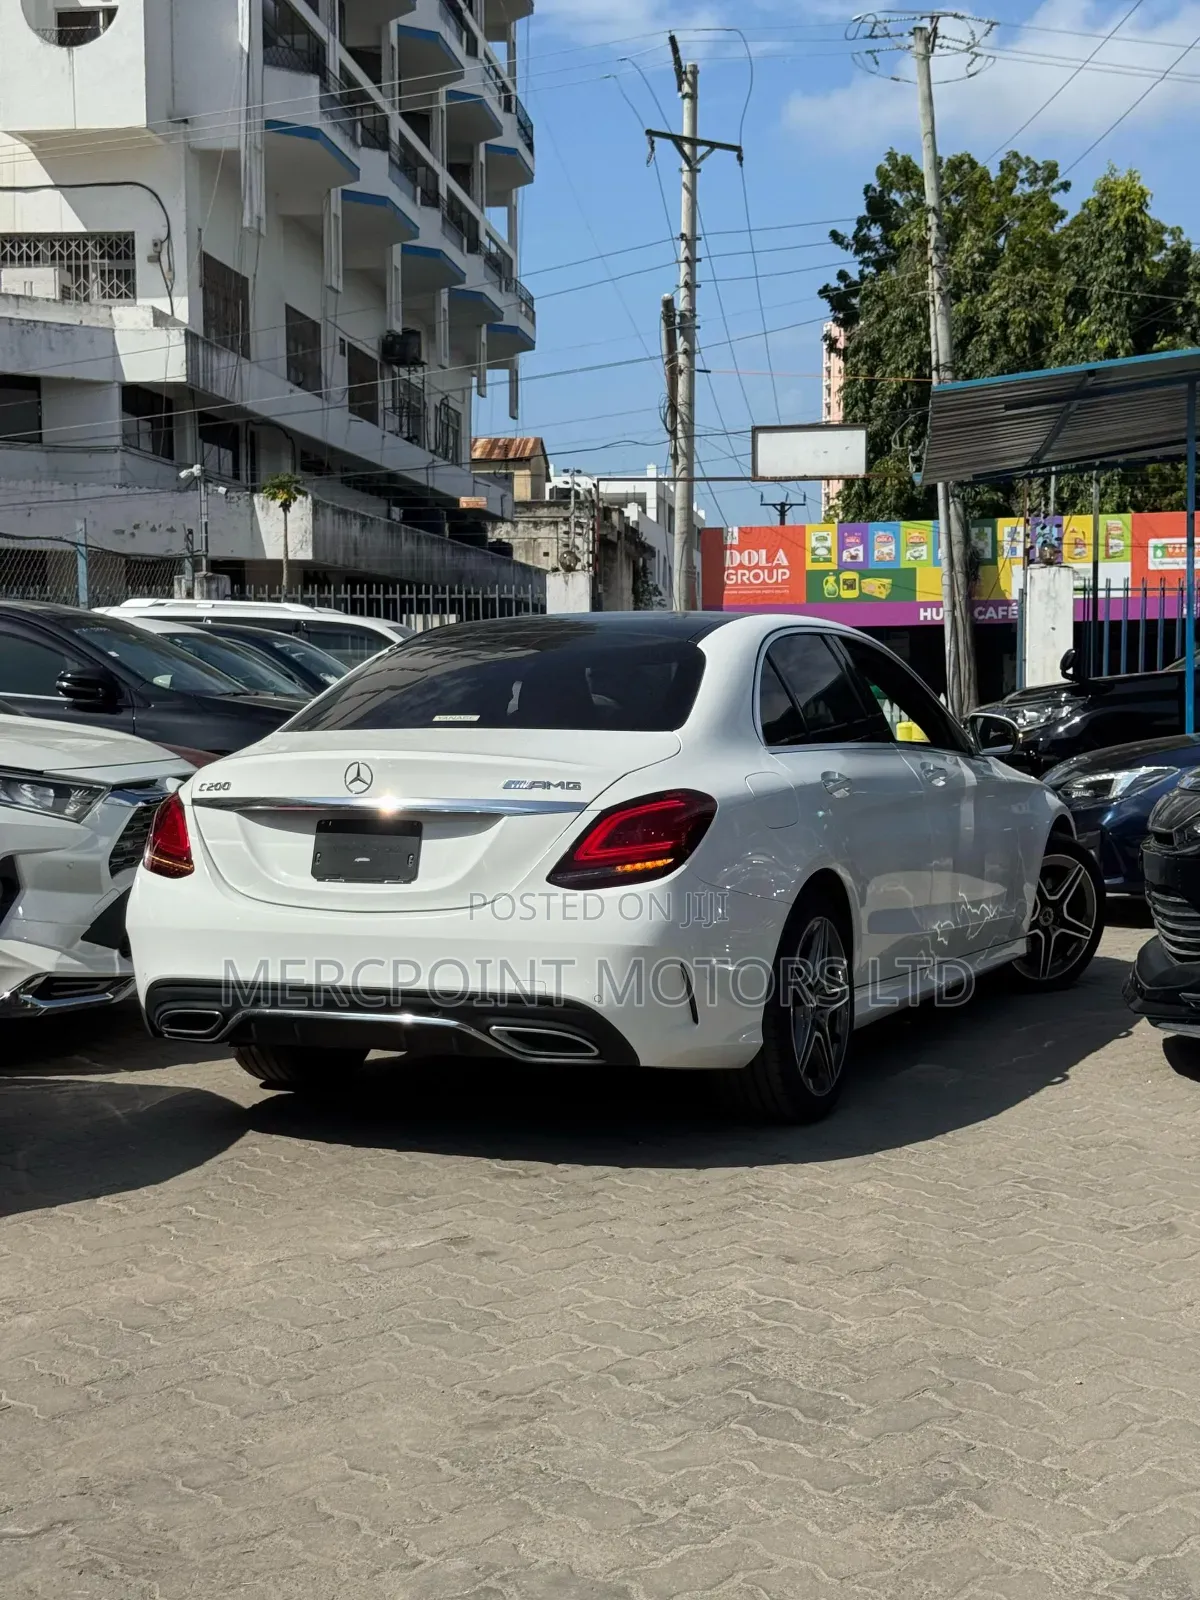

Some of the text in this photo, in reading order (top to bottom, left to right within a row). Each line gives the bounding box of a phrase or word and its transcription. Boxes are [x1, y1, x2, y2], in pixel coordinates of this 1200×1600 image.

[724, 548, 790, 567] DOLA
[724, 568, 790, 584] GROUP
[919, 603, 1018, 620] HU CAFÉ
